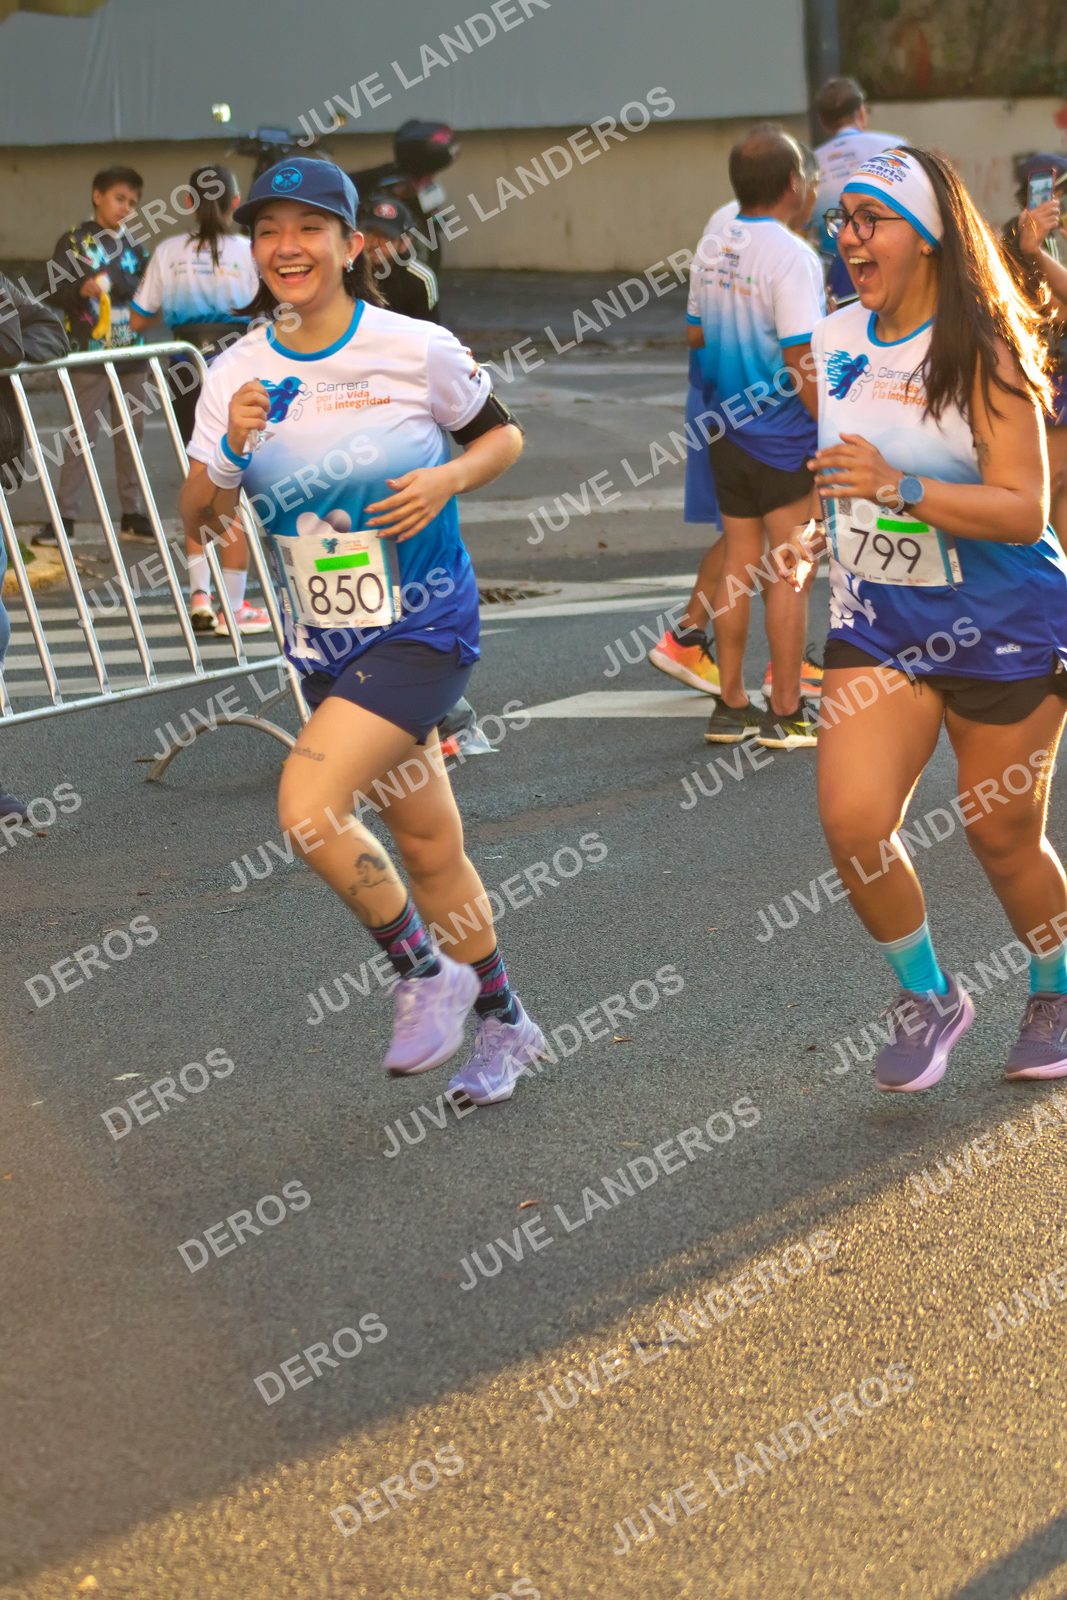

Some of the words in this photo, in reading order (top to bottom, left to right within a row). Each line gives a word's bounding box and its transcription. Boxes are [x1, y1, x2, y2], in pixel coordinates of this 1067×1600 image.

[316, 380, 369, 393] Carrera
[316, 394, 331, 404] por
[346, 390, 370, 399] Vida
[335, 395, 391, 409] Integridad
[849, 527, 922, 574] 799
